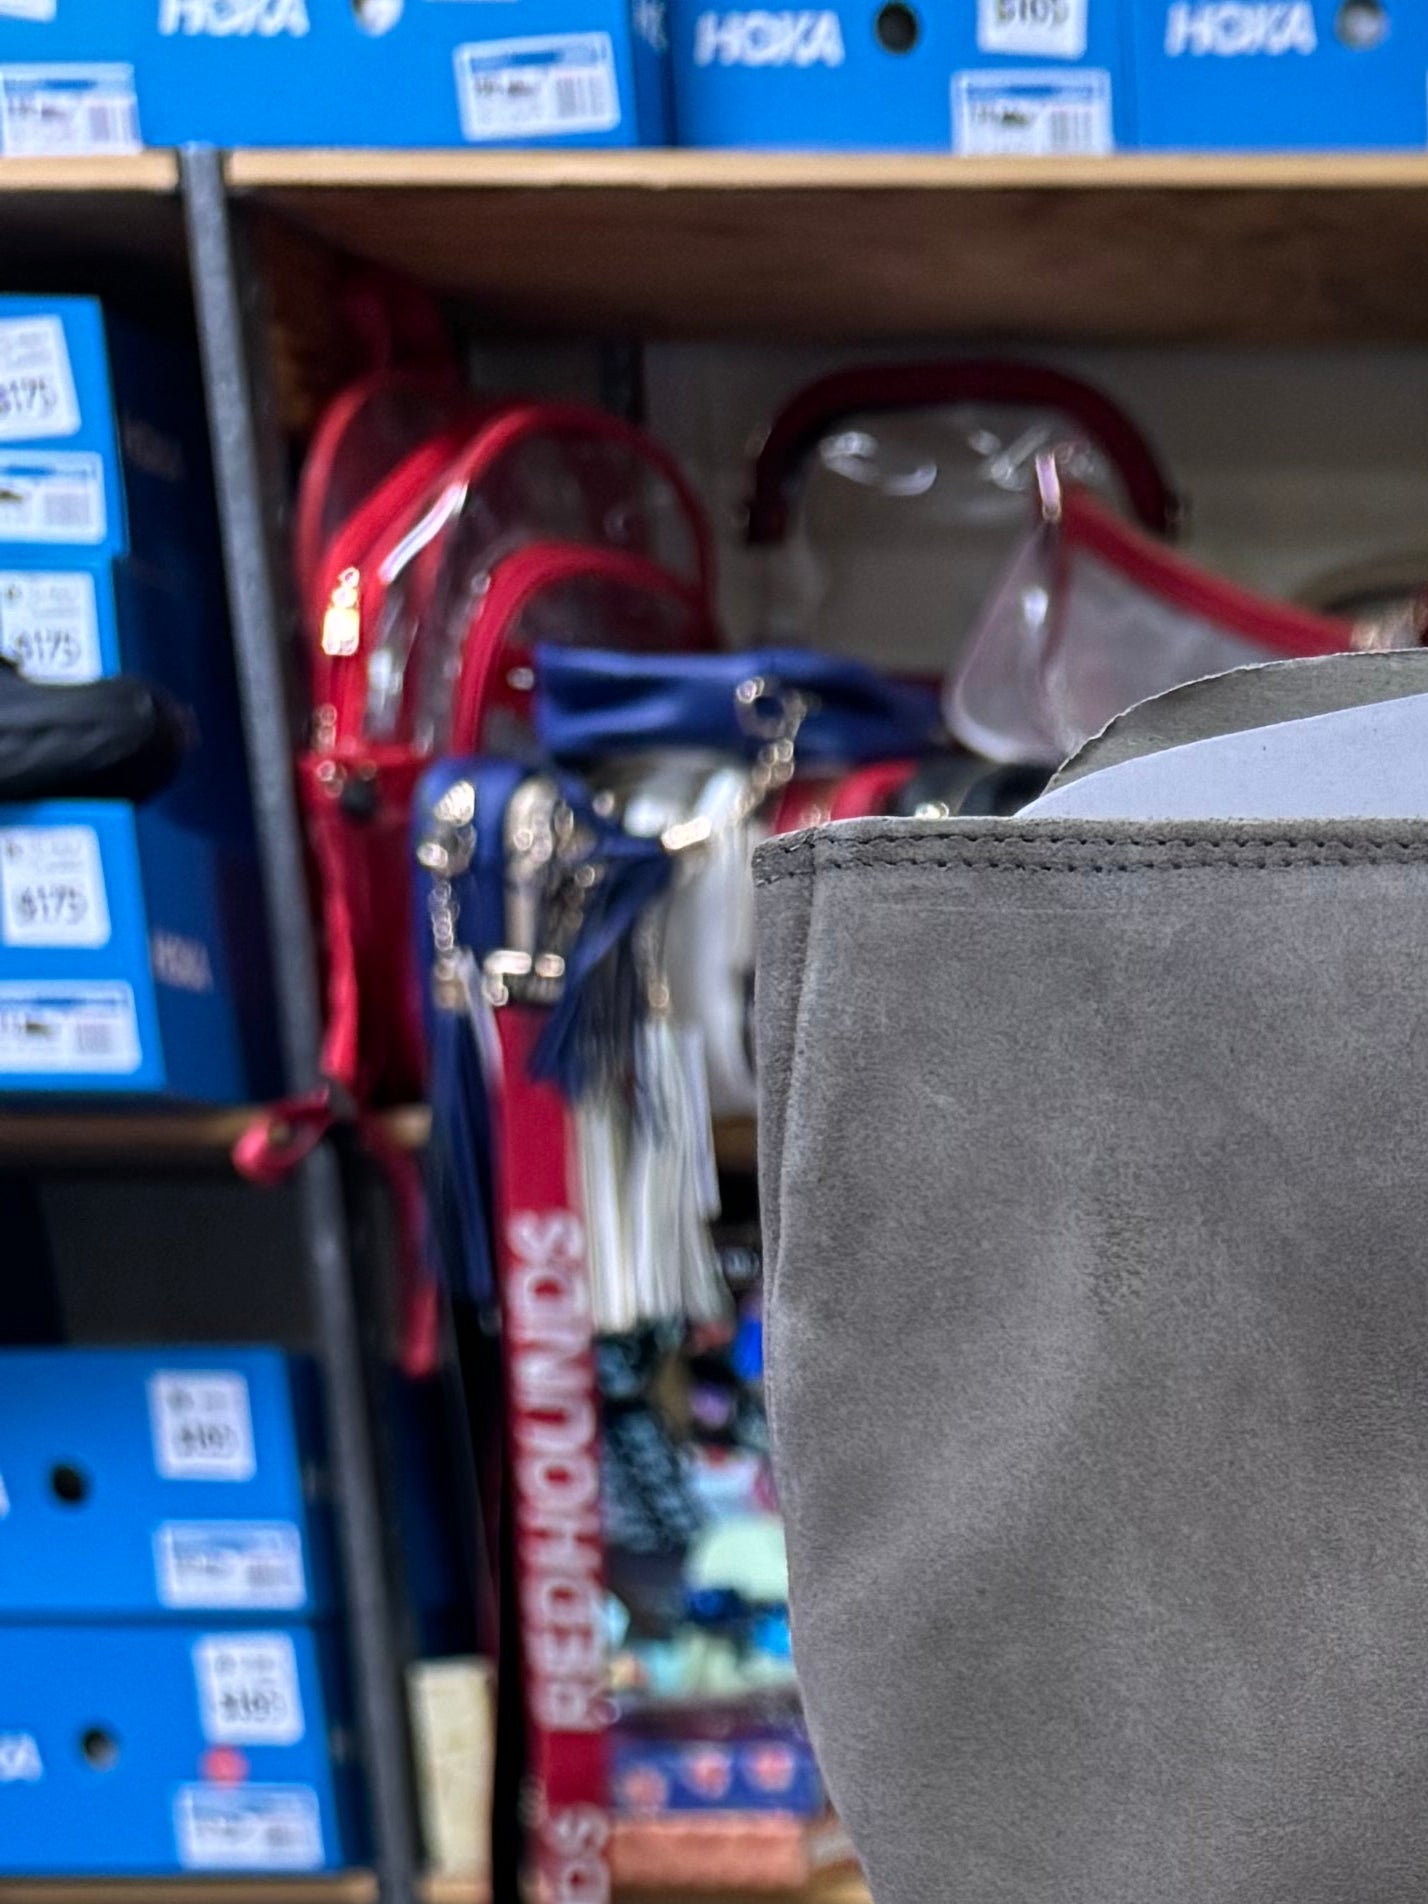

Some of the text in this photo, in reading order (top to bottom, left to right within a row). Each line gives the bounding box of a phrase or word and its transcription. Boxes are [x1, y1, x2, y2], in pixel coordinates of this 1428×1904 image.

[694, 9, 845, 68] HOKA
[1164, 1, 1317, 57] HOKA
[508, 1209, 612, 1732] REDHOUNDS
